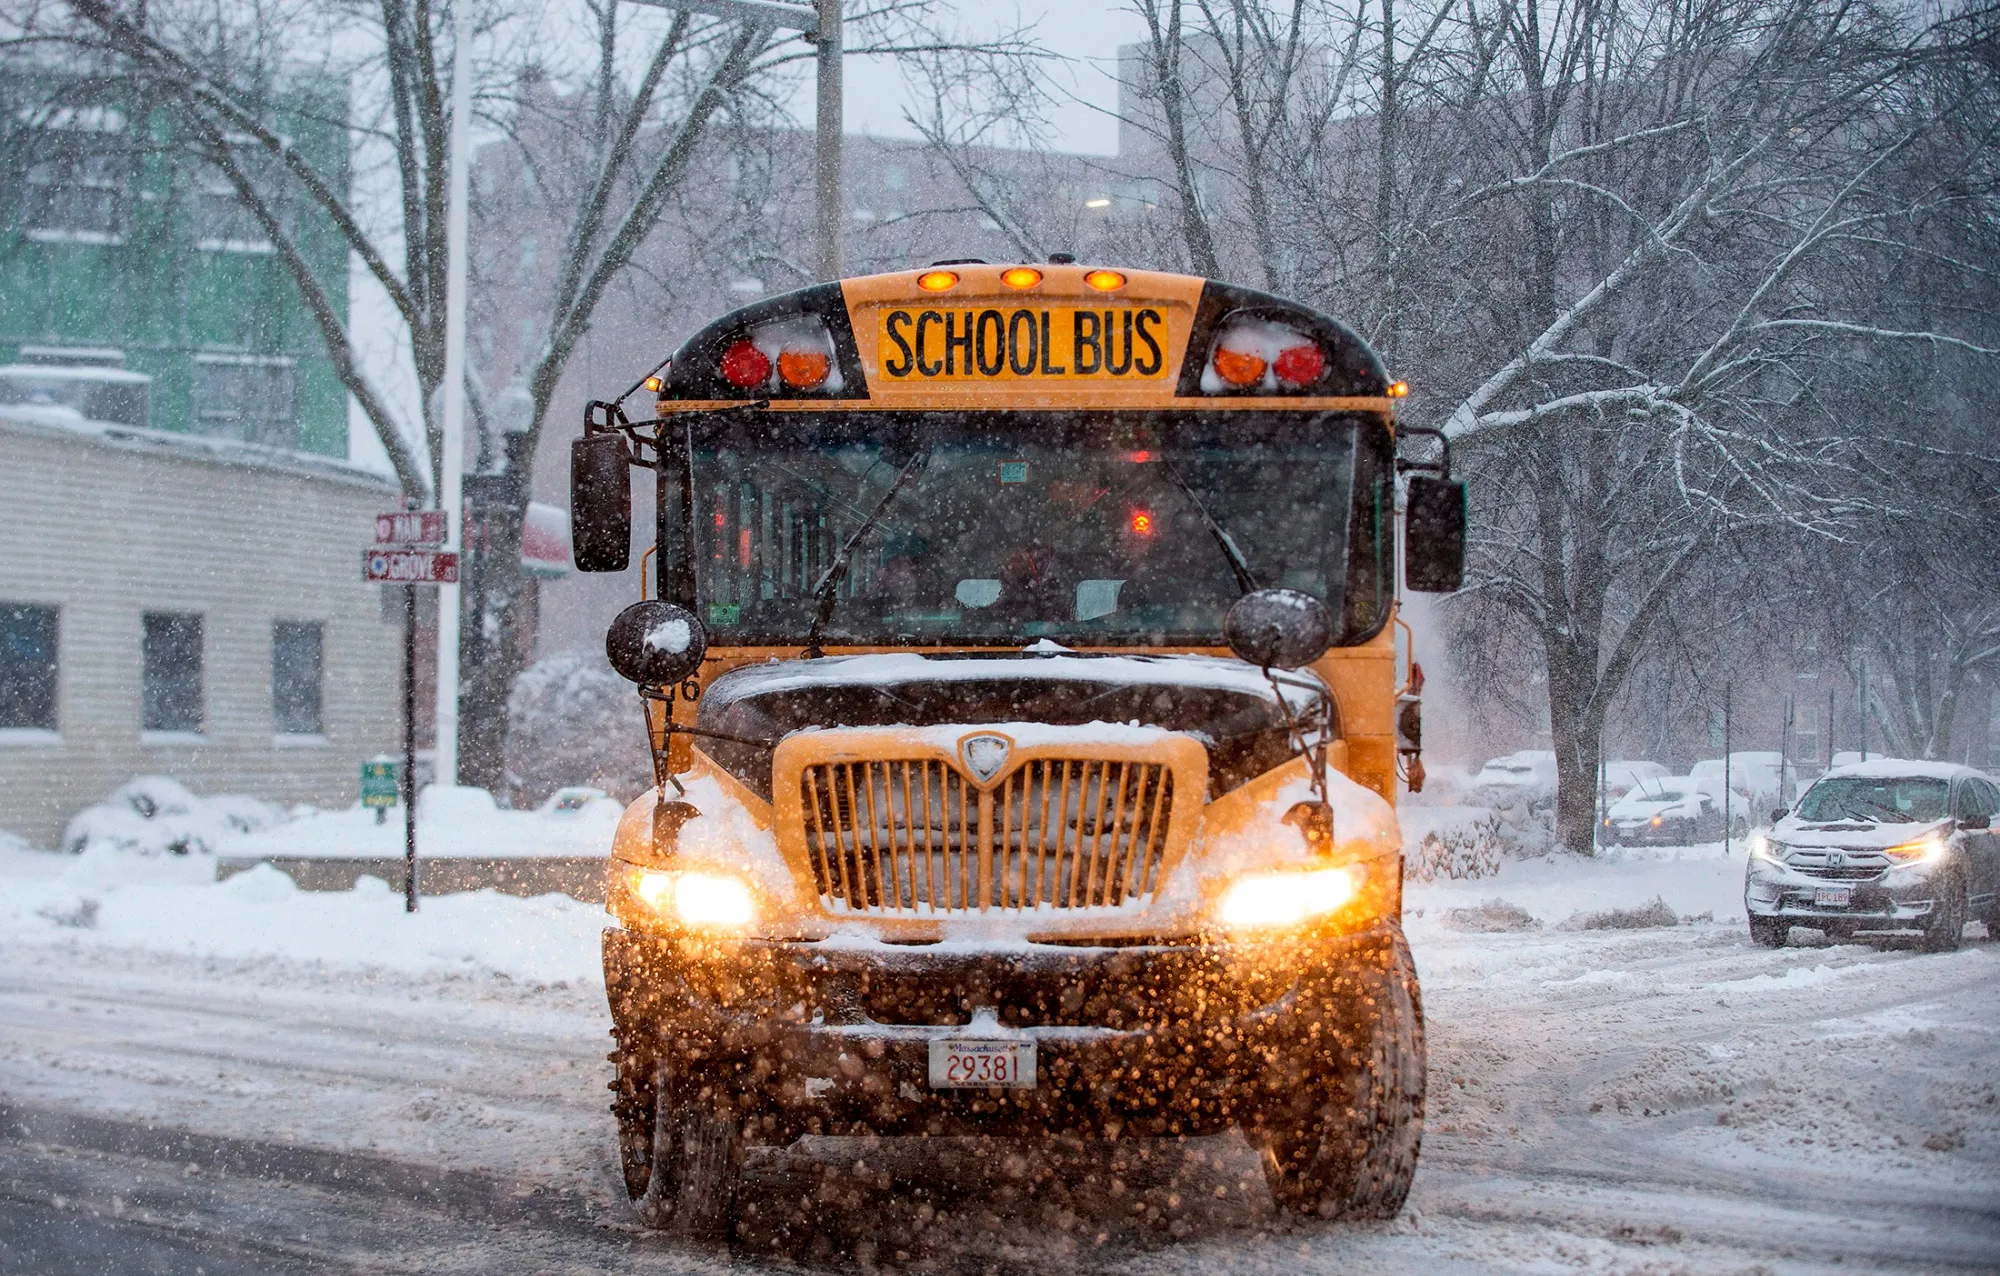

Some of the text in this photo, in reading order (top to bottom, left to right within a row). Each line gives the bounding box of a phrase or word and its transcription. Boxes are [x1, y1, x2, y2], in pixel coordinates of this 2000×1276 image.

[885, 309, 1163, 377] SCHOOL BUS
[394, 515, 421, 541] MAIN
[390, 553, 434, 580] GROVE
[953, 1043, 1012, 1053] Massachusetts
[947, 1054, 1018, 1081] 29381
